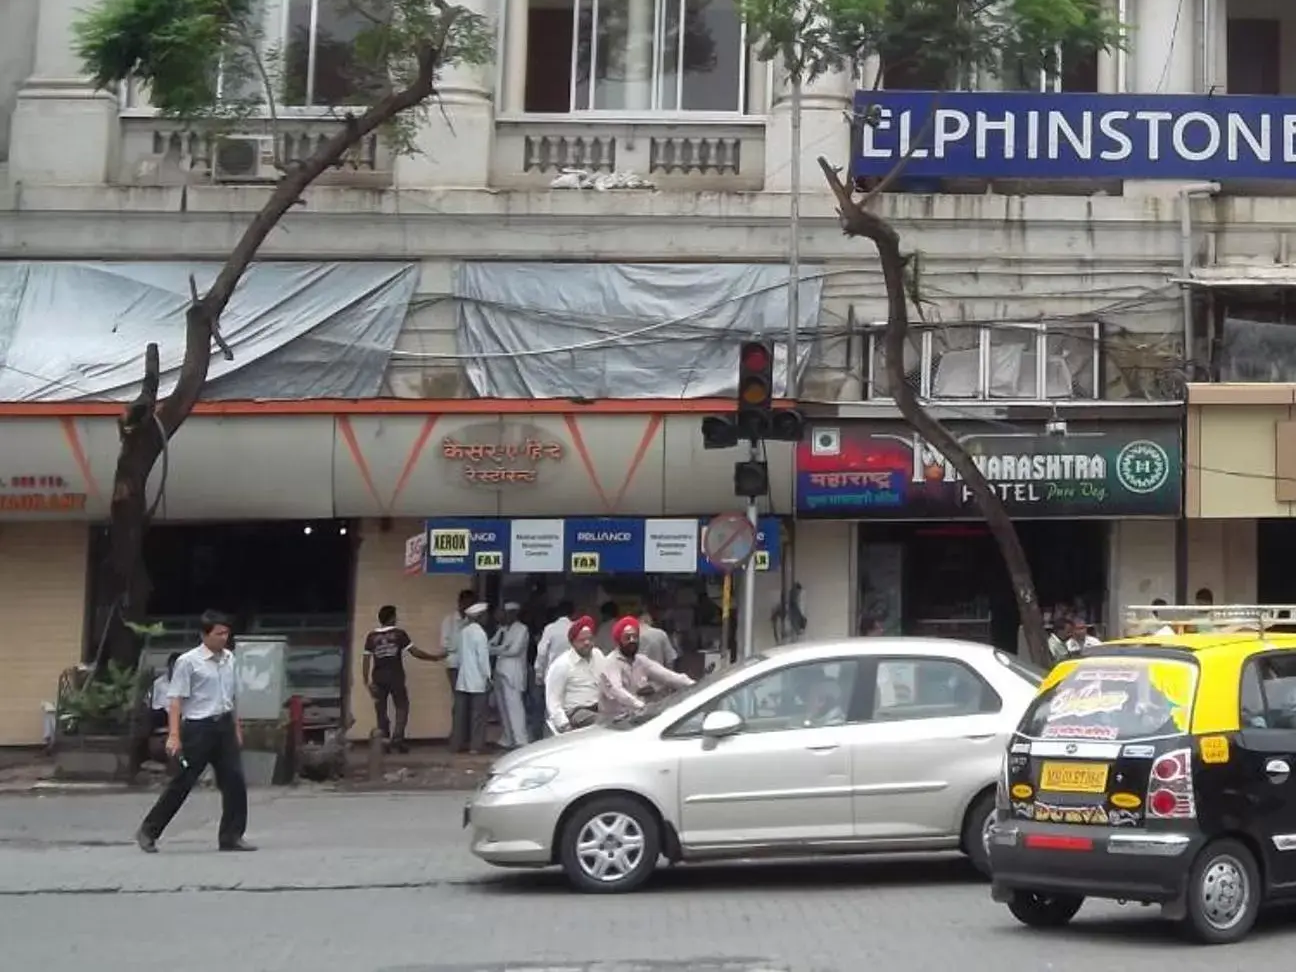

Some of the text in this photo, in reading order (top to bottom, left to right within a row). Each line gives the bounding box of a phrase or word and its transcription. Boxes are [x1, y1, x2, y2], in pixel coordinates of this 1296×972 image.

[962, 483, 1040, 502] HTEL
[433, 533, 466, 550] XEROX
[576, 532, 632, 541] RELIANCE
[477, 555, 500, 566] FAX
[573, 556, 597, 568] FAX
